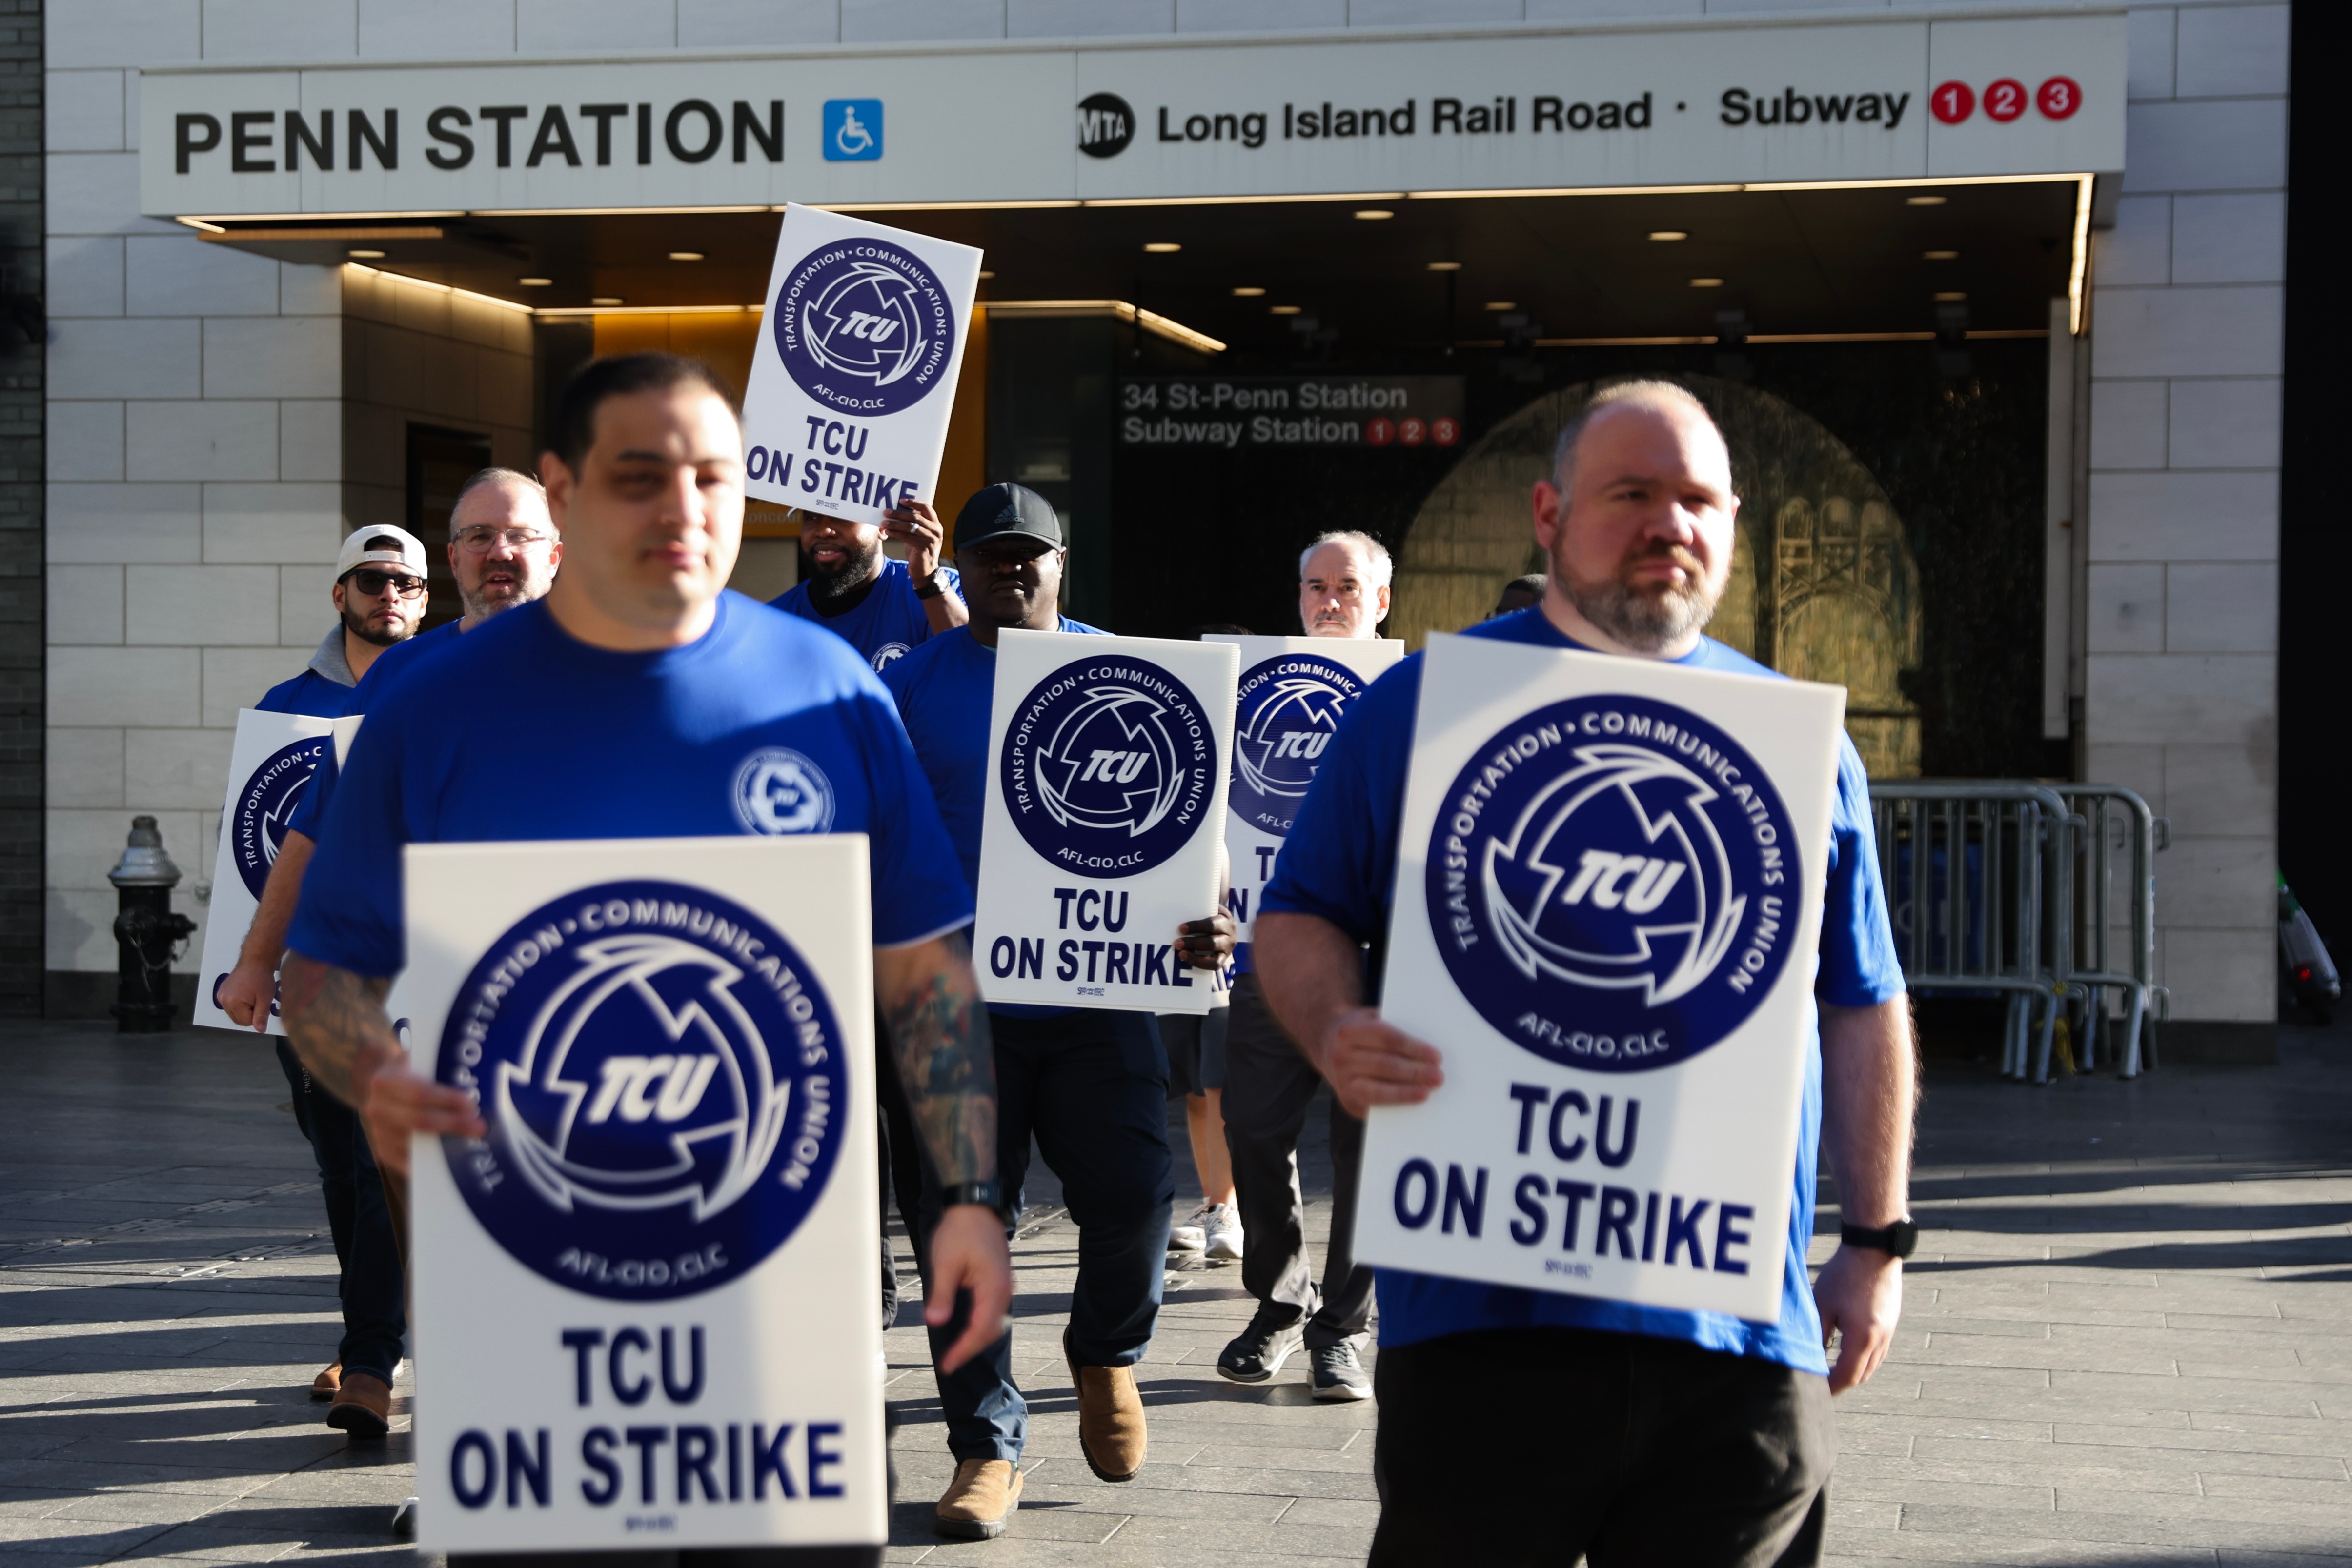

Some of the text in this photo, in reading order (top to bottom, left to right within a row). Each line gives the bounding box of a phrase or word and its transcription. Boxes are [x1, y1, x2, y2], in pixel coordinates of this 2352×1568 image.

[175, 99, 785, 173] PENN STATION
[1078, 107, 1126, 145] MTA
[1159, 84, 2071, 148] Long Island Rail Road Subway 1 2 3
[785, 246, 946, 385] TRANSPORTATION COMMUNICATIONS UNION
[840, 311, 900, 342] TCU
[1124, 383, 1408, 410] 34 St-Penn Station
[807, 415, 869, 461] TCU
[1124, 417, 1244, 448] Subway
[1251, 416, 1360, 443] Station
[747, 445, 919, 512] ON STRIKE
[1277, 663, 1363, 701] COMMUNICA
[1014, 666, 1206, 825] TRANSPORTATION COMMUNICATIONS UNION
[1080, 749, 1151, 784] TCU
[1274, 731, 1333, 760] TCU
[243, 752, 303, 868] TRANSPORTATION
[1444, 711, 1784, 994] TRANSPORTATION COMMUNICATIONS UNION
[1562, 849, 1688, 915] TCU
[1054, 887, 1130, 933] TCU
[1229, 888, 1248, 923] N
[991, 935, 1045, 979] ON
[1057, 941, 1194, 988] STRIKE
[582, 899, 828, 1066] COMMUNICATIONS
[782, 1076, 830, 1191] UNION
[586, 1055, 719, 1124] TCU
[1509, 1081, 1641, 1169] TCU
[1393, 1157, 1755, 1277] ON STRIKE
[561, 1327, 706, 1407] TCU
[450, 1422, 845, 1510] ON STRIKE
